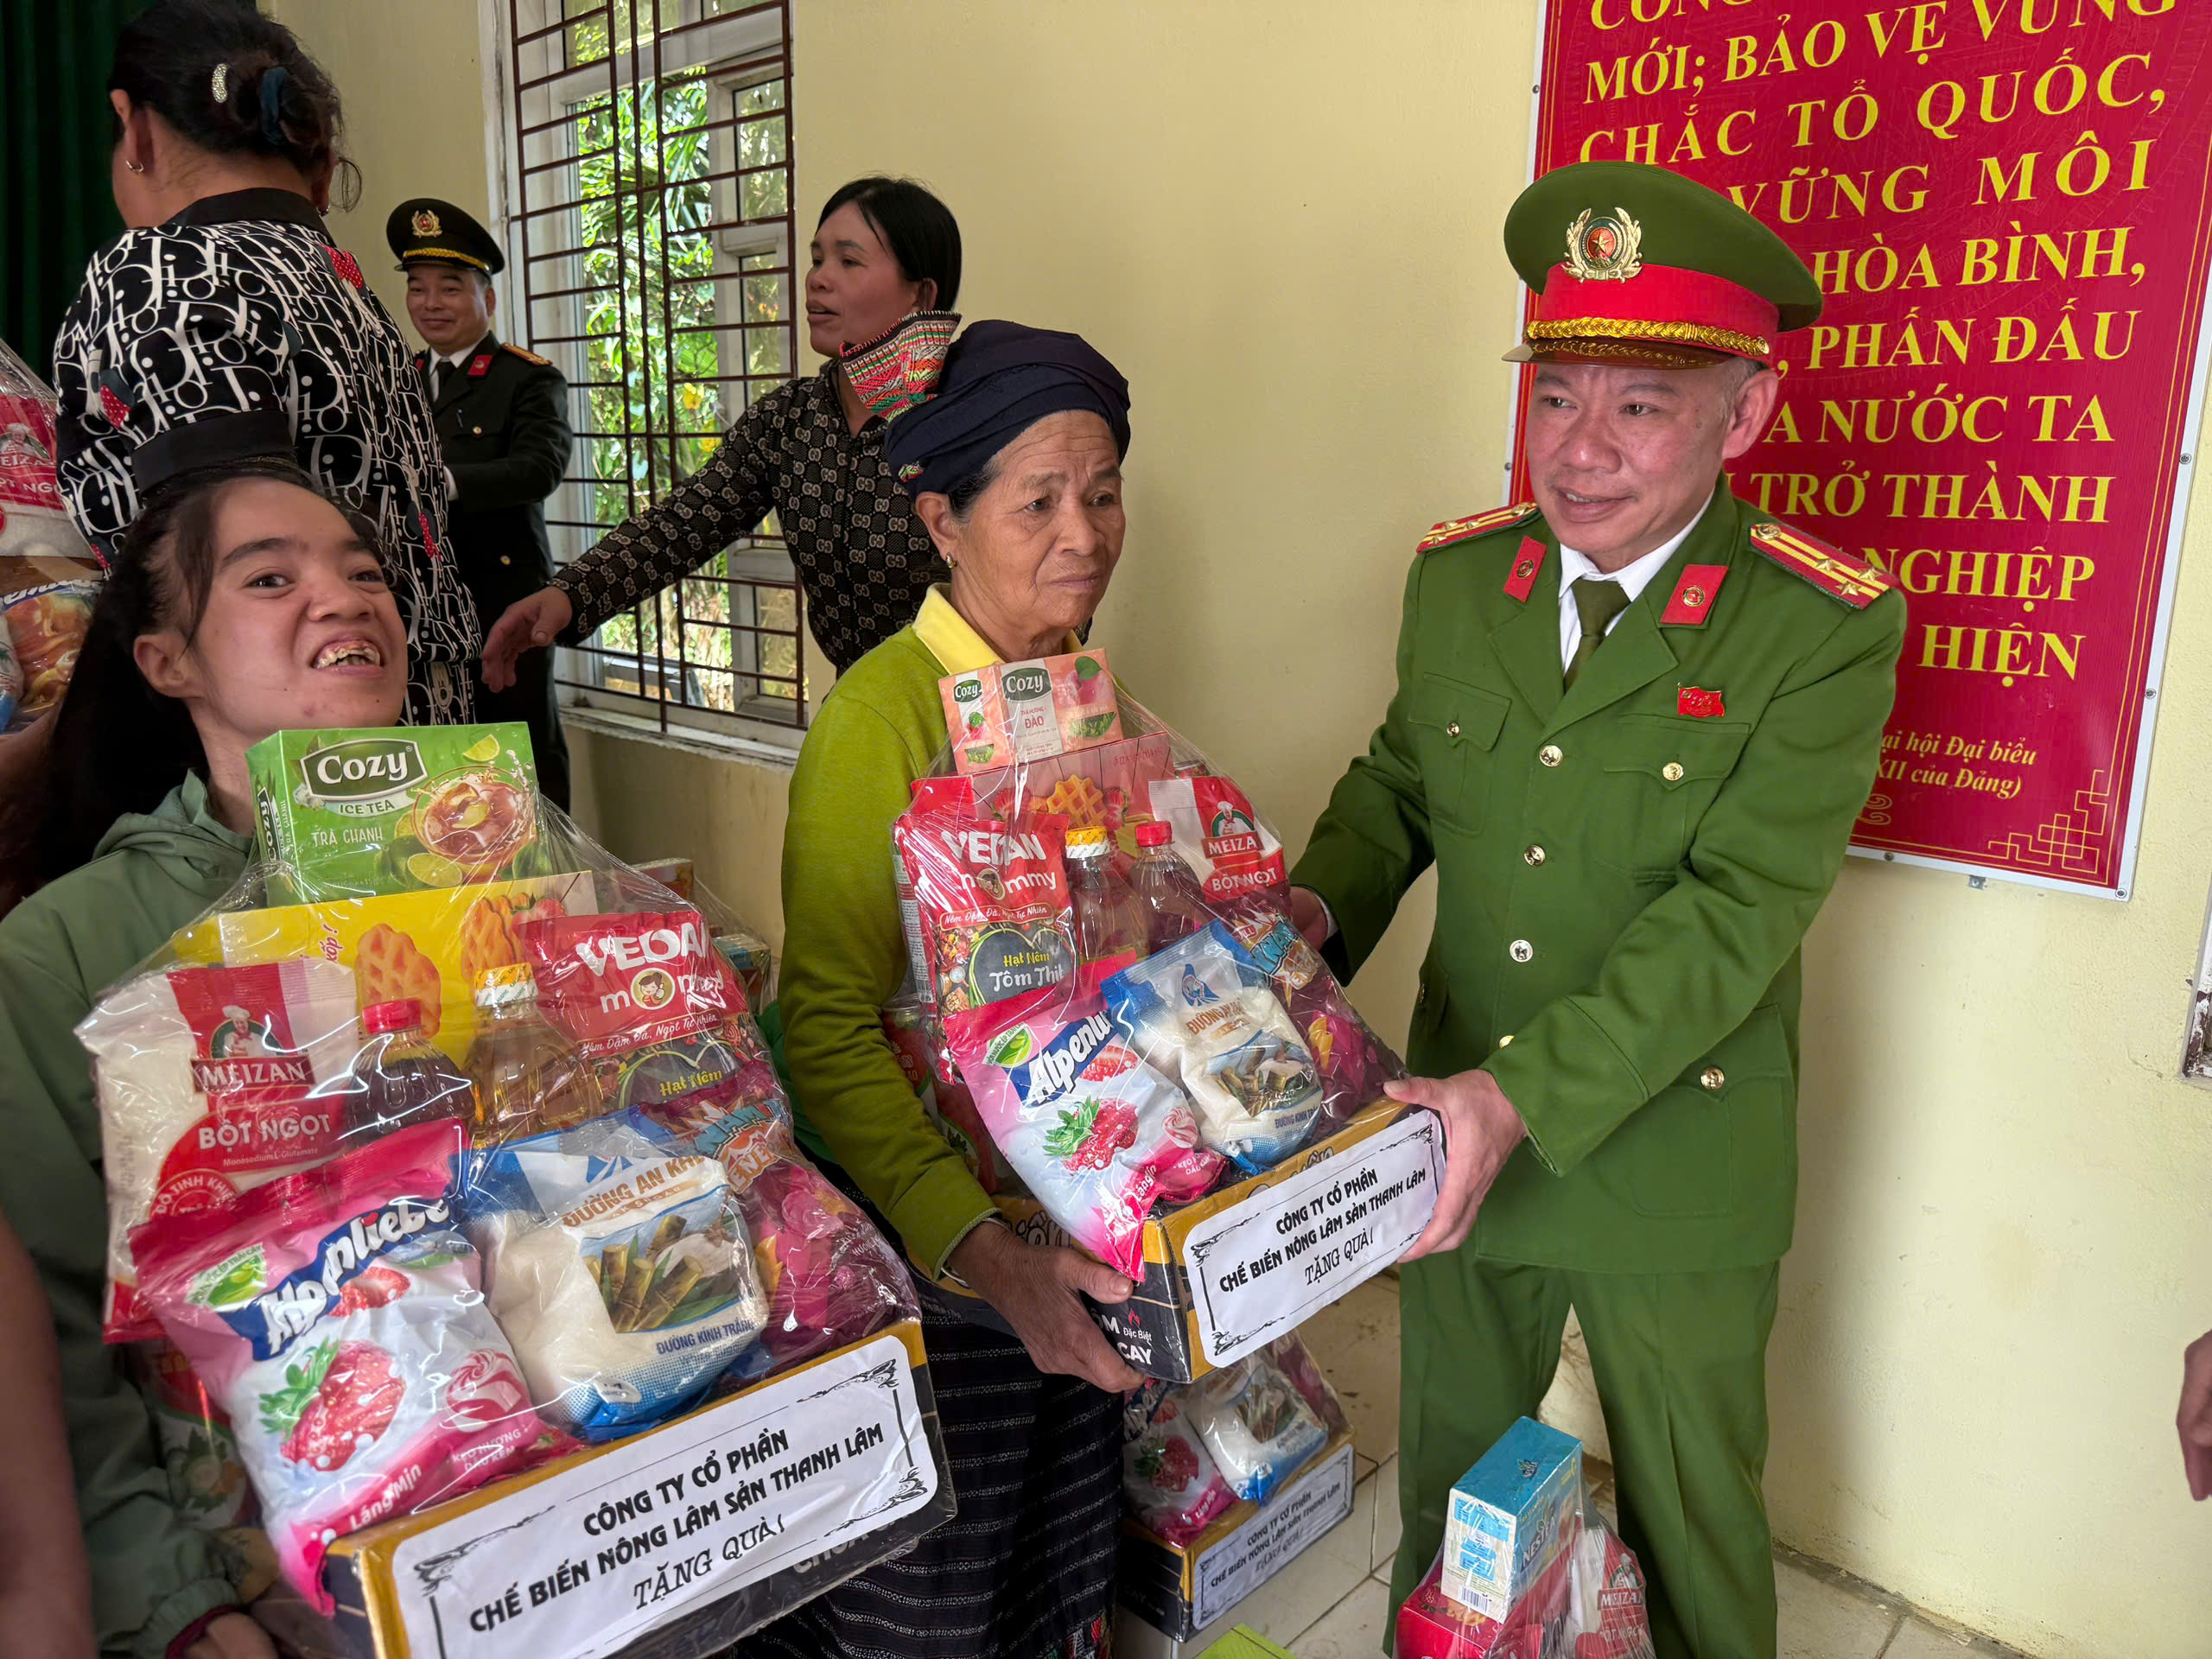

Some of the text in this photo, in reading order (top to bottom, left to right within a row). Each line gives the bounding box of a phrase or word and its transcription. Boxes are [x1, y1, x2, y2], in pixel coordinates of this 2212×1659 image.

[1583, 37, 1705, 104] MỚI;
[1721, 14, 1847, 82] BẢO
[1580, 48, 2165, 166] CHẮC TỔ QUỐC,
[1726, 130, 2158, 225] VỮNG MÔI
[1812, 220, 2146, 295] HÒA BÌNH,
[1804, 297, 2142, 369] PHẤN ĐẤU
[1817, 383, 2008, 443] NƯỚC
[2027, 394, 2115, 442] TA
[1750, 460, 1871, 518] TRỞ
[1883, 461, 2116, 524] THÀNH
[1916, 623, 2087, 687] HIỆN
[955, 683, 978, 699] Cozy
[1006, 672, 1044, 693] Cozy
[1025, 715, 1044, 729] ĐÀO
[1881, 730, 2037, 766] ại hội Đại biểu
[317, 751, 409, 784] Cozy
[1910, 765, 1948, 786] của
[1954, 767, 2022, 800] Đảng)
[339, 798, 396, 815] ICE TEA
[311, 823, 383, 848] TRÀ CHANH
[1208, 838, 1258, 857] MEIZA
[1211, 874, 1240, 897] BỘT
[1003, 950, 1050, 969] Hạt Nêm
[989, 968, 1032, 992] Tôm
[607, 1037, 631, 1050] Đậm
[656, 1023, 681, 1039] Ngọt
[696, 1014, 718, 1027] Nhiên
[201, 1062, 306, 1087] MEIZAN
[659, 1070, 722, 1097] Hạt Nêm
[199, 1114, 331, 1153] BỘT NGỌT
[170, 1175, 204, 1195] TINH
[563, 1182, 636, 1228] ĐƯỜNG
[635, 1167, 665, 1194] AN
[1275, 1167, 1378, 1235] CÔNG TY CỔ PHẦN
[1219, 1167, 1426, 1293] CHẾ BIẾN NÔNG LÂM SẢN THANH LÂM
[1305, 1248, 1340, 1286] TẶNG
[656, 1333, 695, 1355] ĐƯỜNG
[697, 1326, 722, 1344] KÍNH
[1123, 1327, 1152, 1341] Đặc Biệt
[1117, 1342, 1152, 1365] CAY
[584, 1428, 789, 1537] CÔNG TY CỔ PHẦN
[350, 1488, 394, 1530] Láng
[470, 1422, 884, 1632] CHẾ BIẾN NÔNG LÂM SẢN THANH LÂM
[1247, 1525, 1268, 1546] CÔNG
[1270, 1515, 1279, 1529] TY
[1291, 1491, 1312, 1513] PHẦN
[1211, 1567, 1226, 1587] CHẾ
[1228, 1554, 1247, 1576] BIẾN
[1249, 1538, 1270, 1561] NÔNG
[1271, 1525, 1286, 1545] LÂM
[1302, 1496, 1326, 1518] THANH
[633, 1550, 713, 1611] TẶNG
